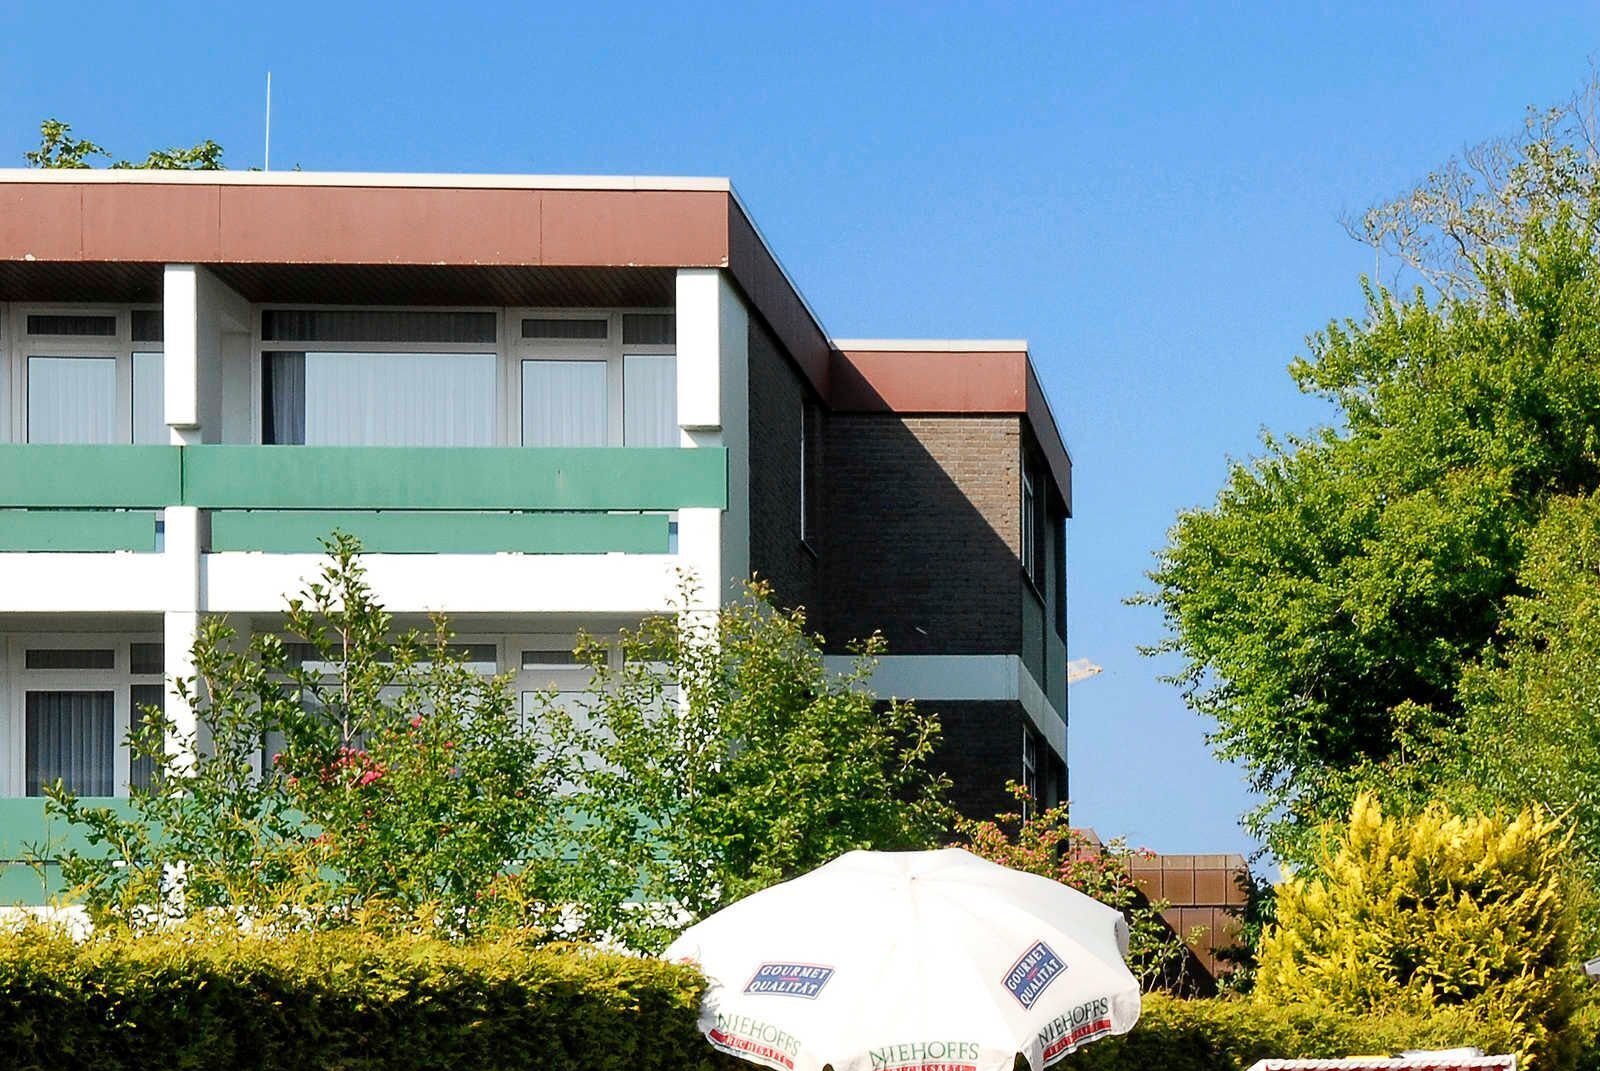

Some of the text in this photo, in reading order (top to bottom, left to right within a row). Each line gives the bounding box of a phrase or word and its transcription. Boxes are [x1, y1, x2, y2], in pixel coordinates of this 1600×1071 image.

[760, 965, 830, 980] GOURMET
[1007, 944, 1046, 991] GOURMET
[717, 1012, 802, 1057] NIEHOFFS
[1038, 996, 1109, 1049] NIEHOFFS
[869, 1041, 980, 1067] NIEHOFFS
